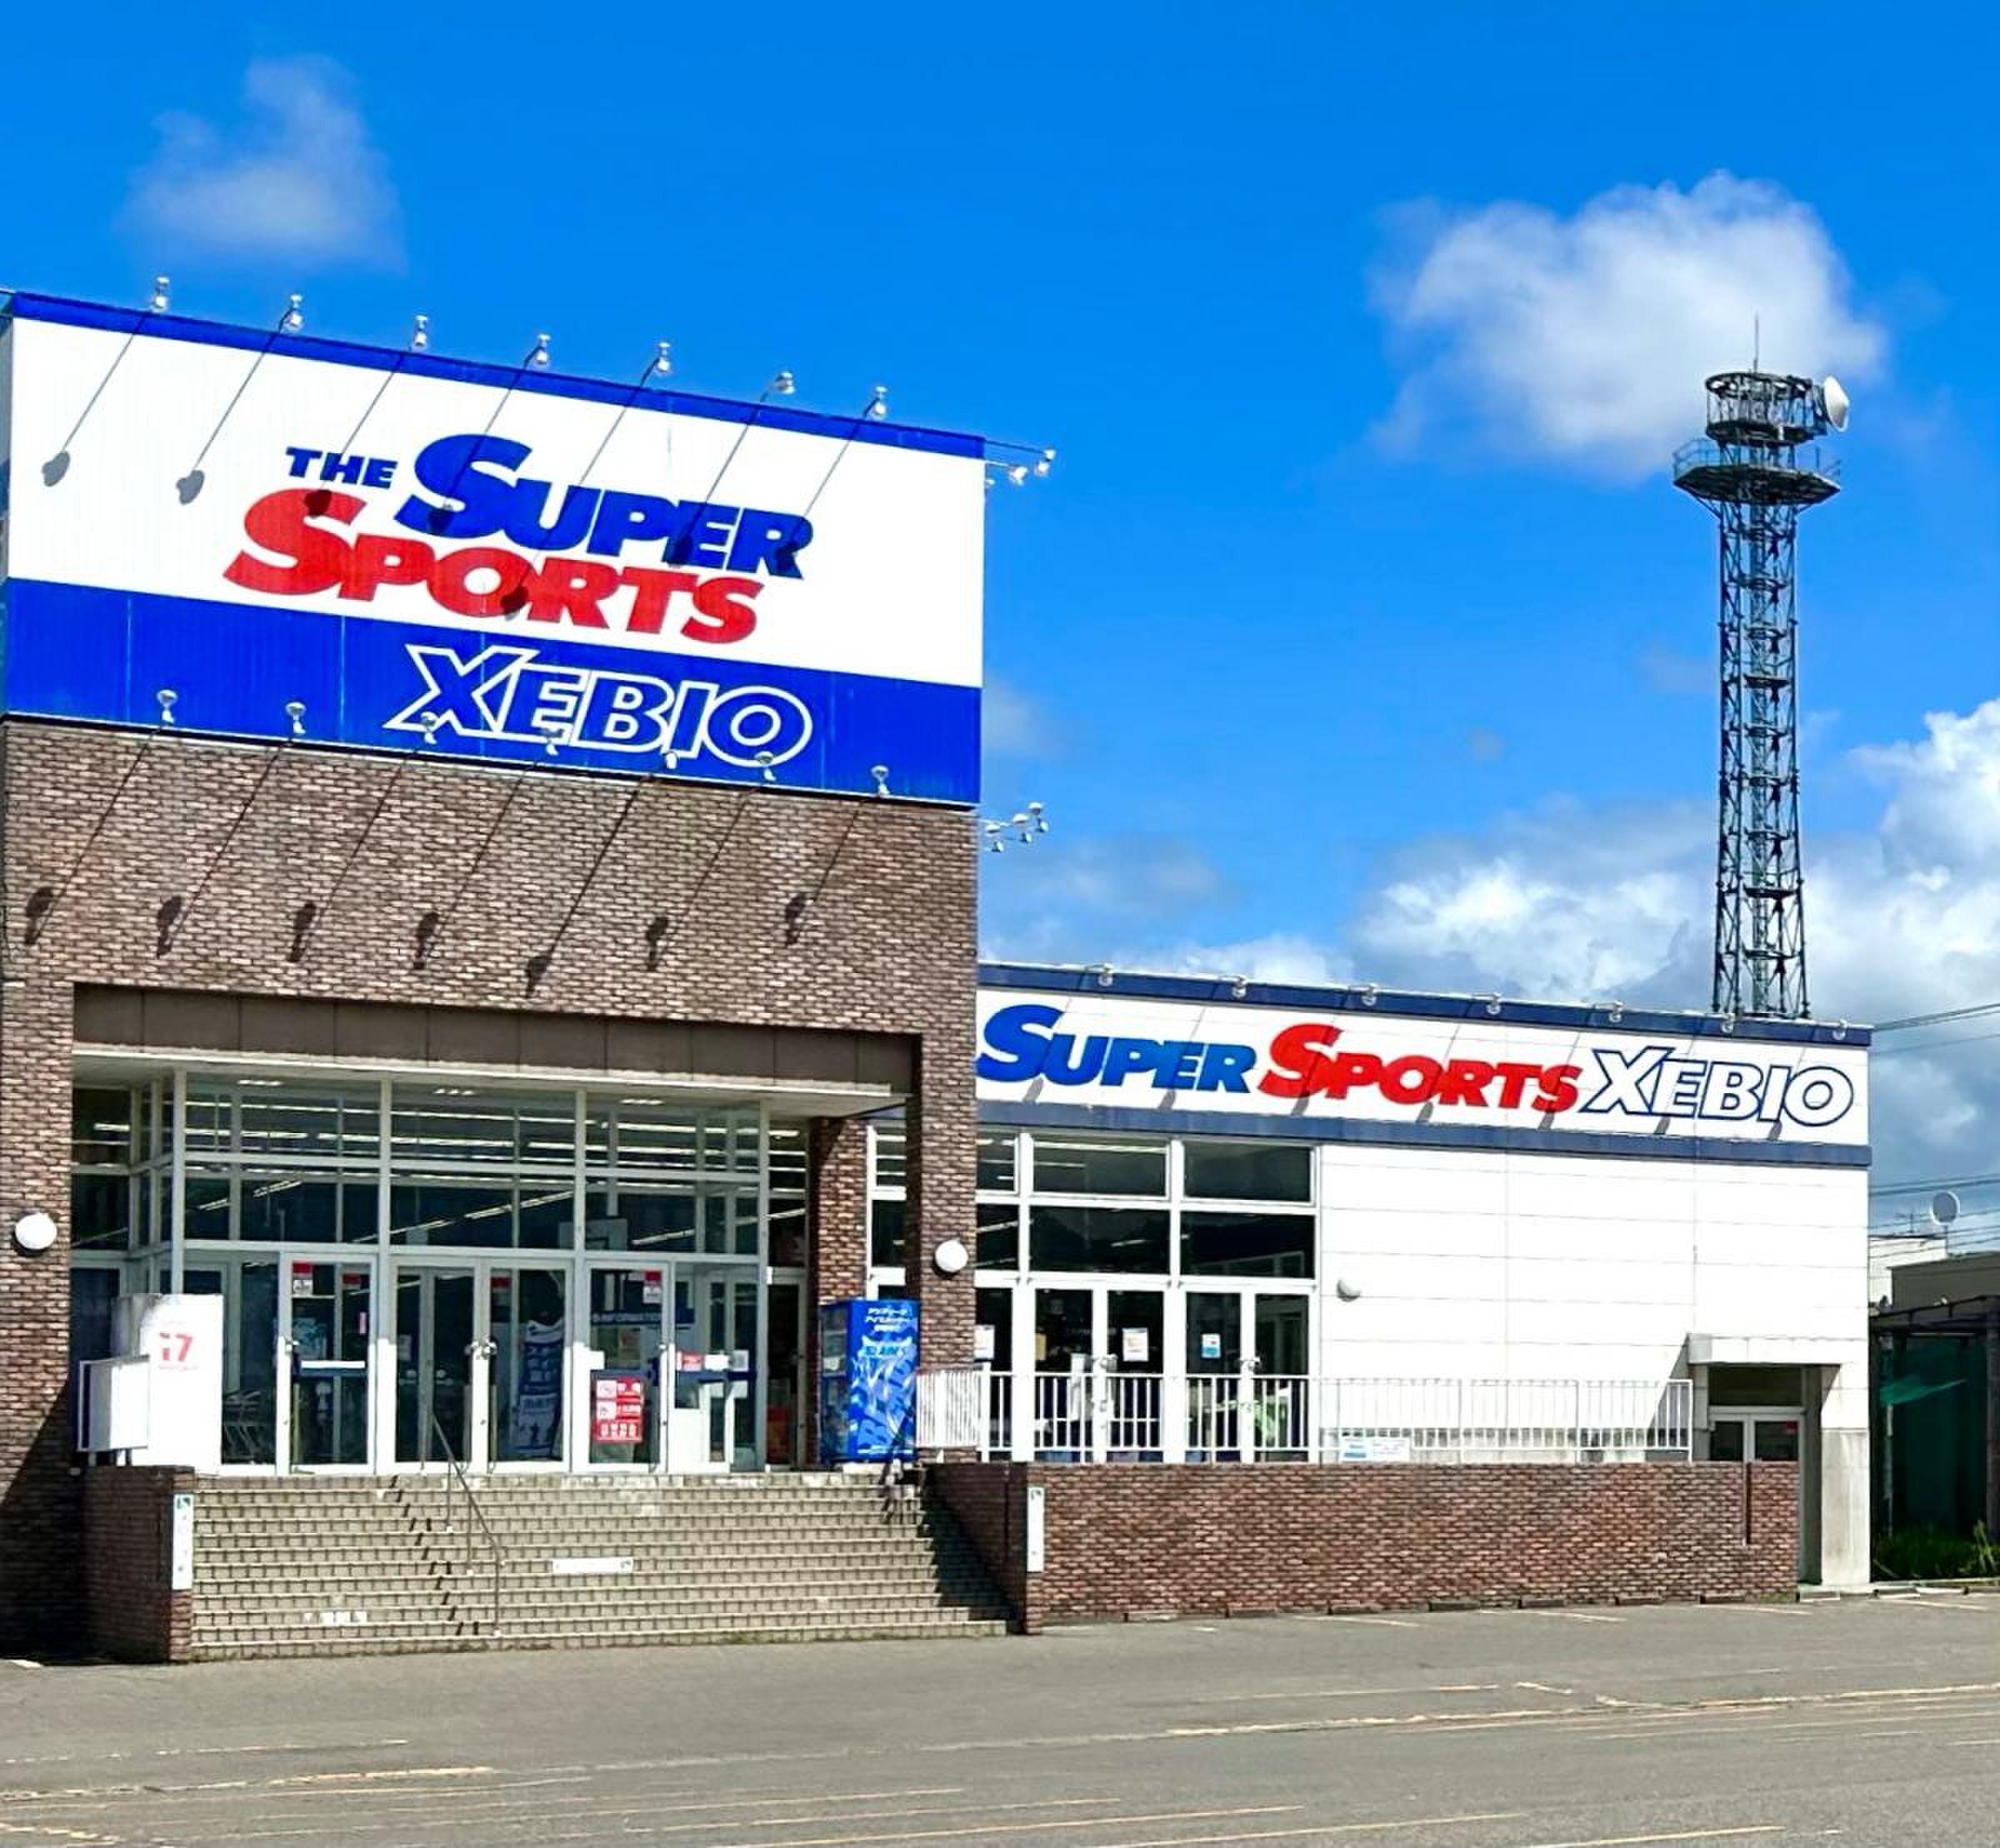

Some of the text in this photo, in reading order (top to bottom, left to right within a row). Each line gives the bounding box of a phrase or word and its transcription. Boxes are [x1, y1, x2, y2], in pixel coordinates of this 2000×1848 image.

[222, 487, 765, 644] SPORTS
[285, 433, 814, 579] THE SUPER
[384, 643, 813, 767] XEBIO
[976, 1004, 1854, 1127] SUPER SPORTS XEBIO
